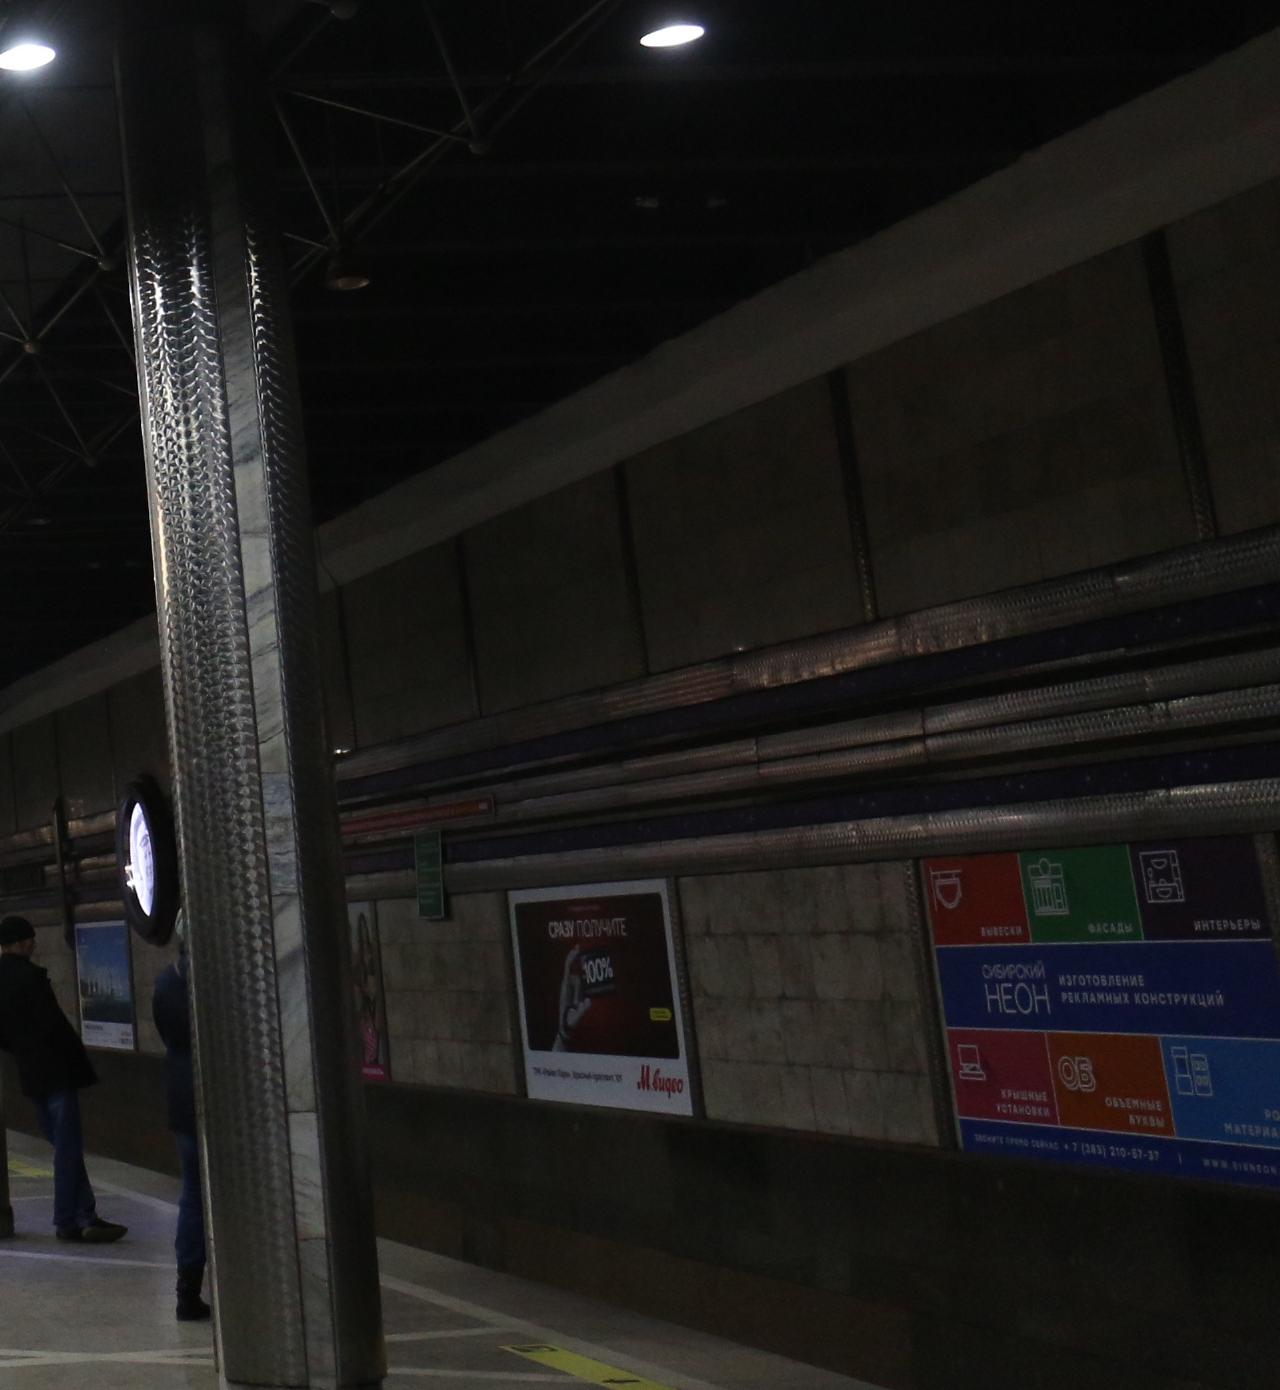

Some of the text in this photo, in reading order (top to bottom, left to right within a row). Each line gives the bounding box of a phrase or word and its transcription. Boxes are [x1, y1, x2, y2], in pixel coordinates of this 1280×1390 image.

[548, 918, 628, 938] СРАЗУ ПОЛУЧИТЕ
[980, 925, 1023, 937] ВЫВЕСКИ
[1087, 922, 1133, 934] ФАСАДЫ
[1193, 918, 1262, 932] ИНТЕРЬЕРЫ
[583, 956, 614, 984] 100%
[982, 960, 1046, 979] СИБИРСКИЙ
[1058, 974, 1145, 987] ИЗГОТОВЛЕНИЕ
[984, 982, 1052, 1015] НЕОН
[1060, 990, 1225, 1008] РЕКЛАМНЫХ КОНСТРУКЦИЙ
[1000, 1088, 1048, 1102] КРЫШНЫЕ
[996, 1103, 1050, 1118] УСТАНОВКИ
[1128, 1114, 1166, 1128] БУКВЫ
